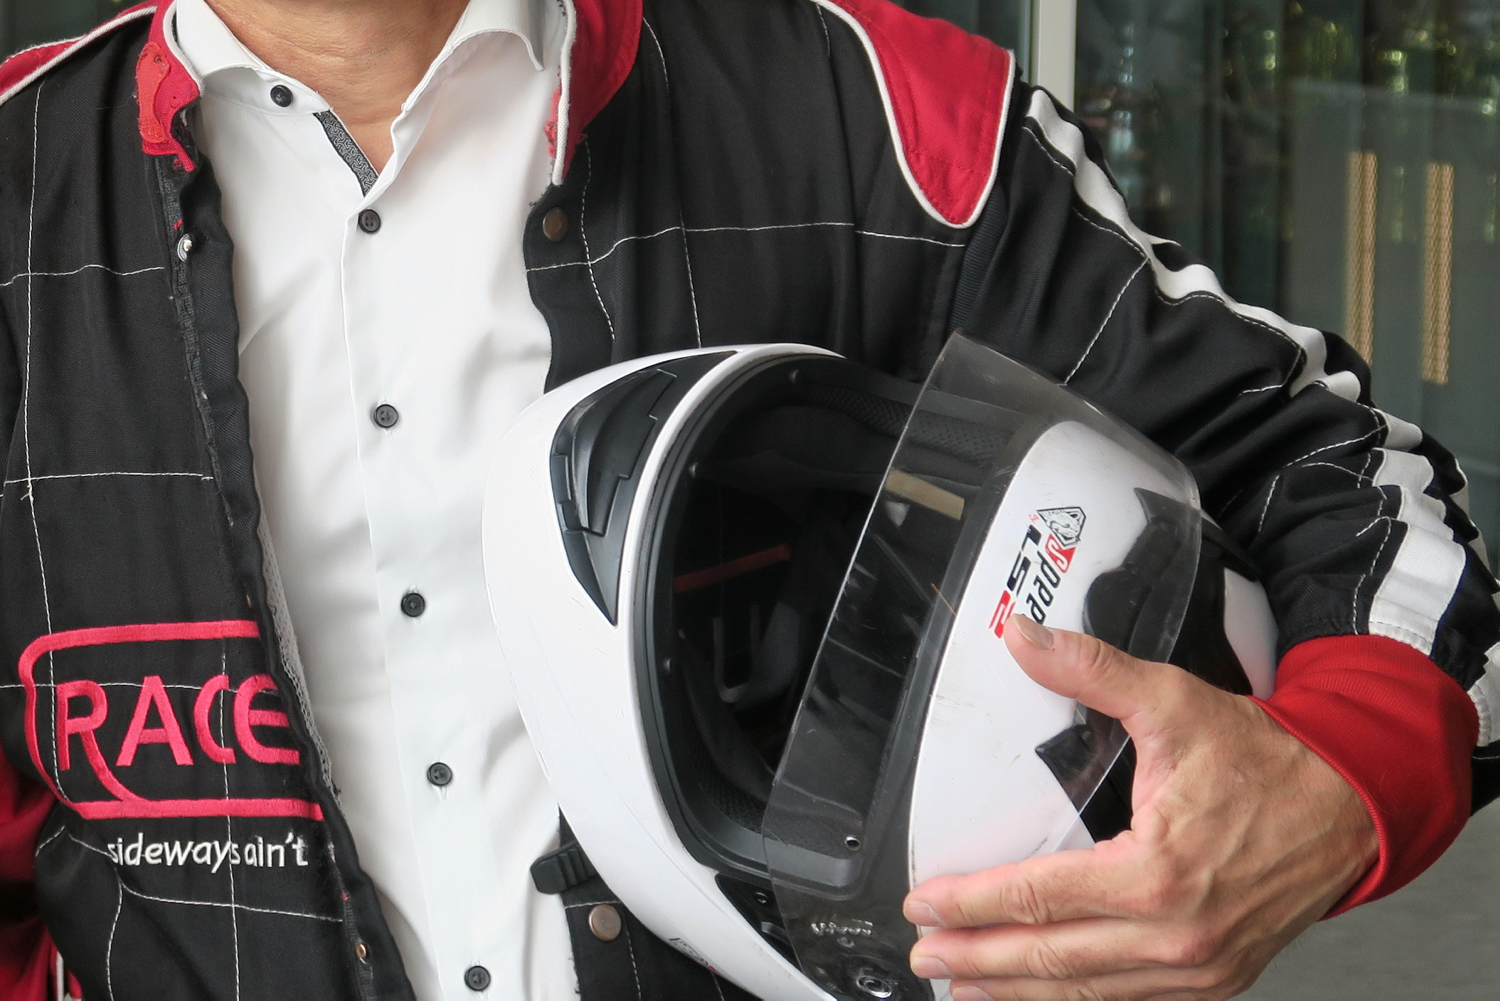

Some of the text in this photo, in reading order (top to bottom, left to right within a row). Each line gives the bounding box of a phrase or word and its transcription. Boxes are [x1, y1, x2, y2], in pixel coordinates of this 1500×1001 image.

[988, 524, 1042, 639] LS2
[1020, 533, 1077, 628] Spee
[55, 673, 301, 772] RACE
[106, 831, 310, 874] sideways ain't
